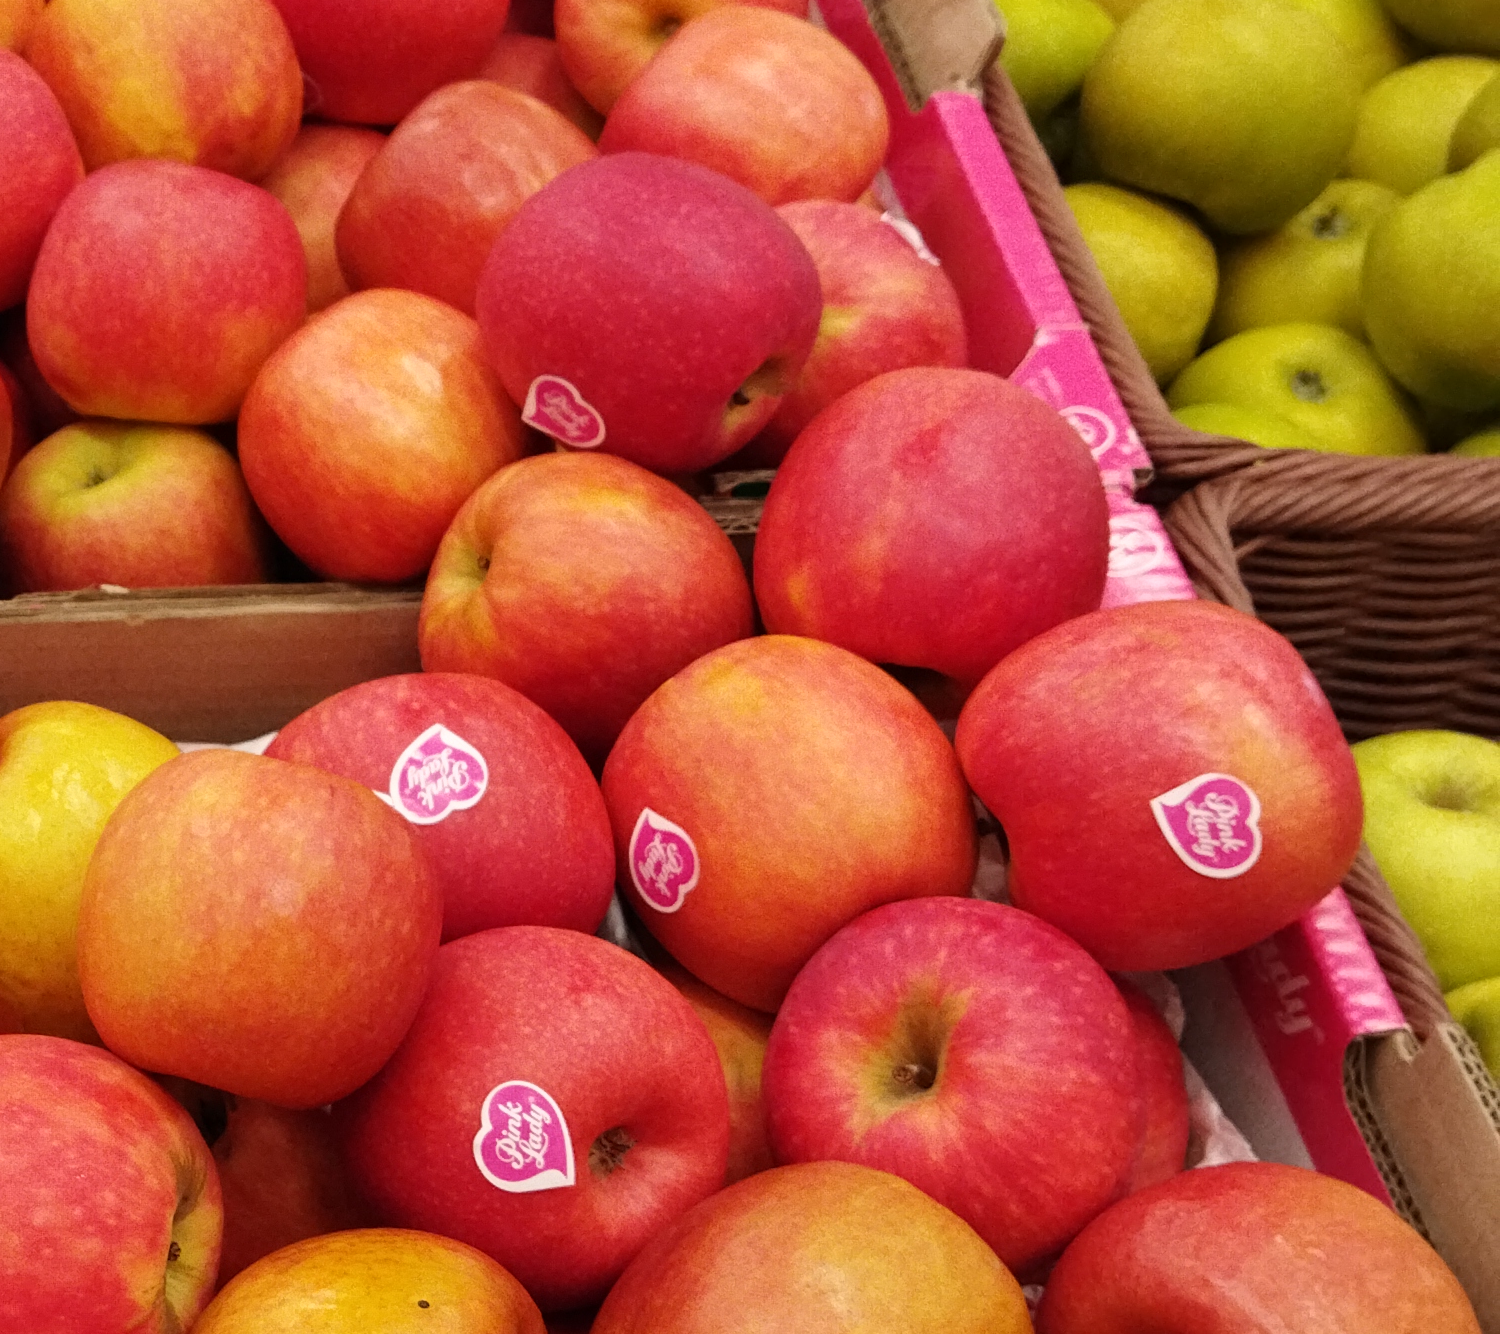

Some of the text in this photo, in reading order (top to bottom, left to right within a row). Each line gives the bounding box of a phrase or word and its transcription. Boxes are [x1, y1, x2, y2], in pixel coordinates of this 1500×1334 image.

[407, 747, 456, 789] Lady
[417, 760, 469, 811] Pink
[1185, 799, 1221, 857] Lady
[1204, 792, 1247, 854] Pink
[495, 1100, 525, 1170] Pink
[519, 1103, 552, 1169] Lady
